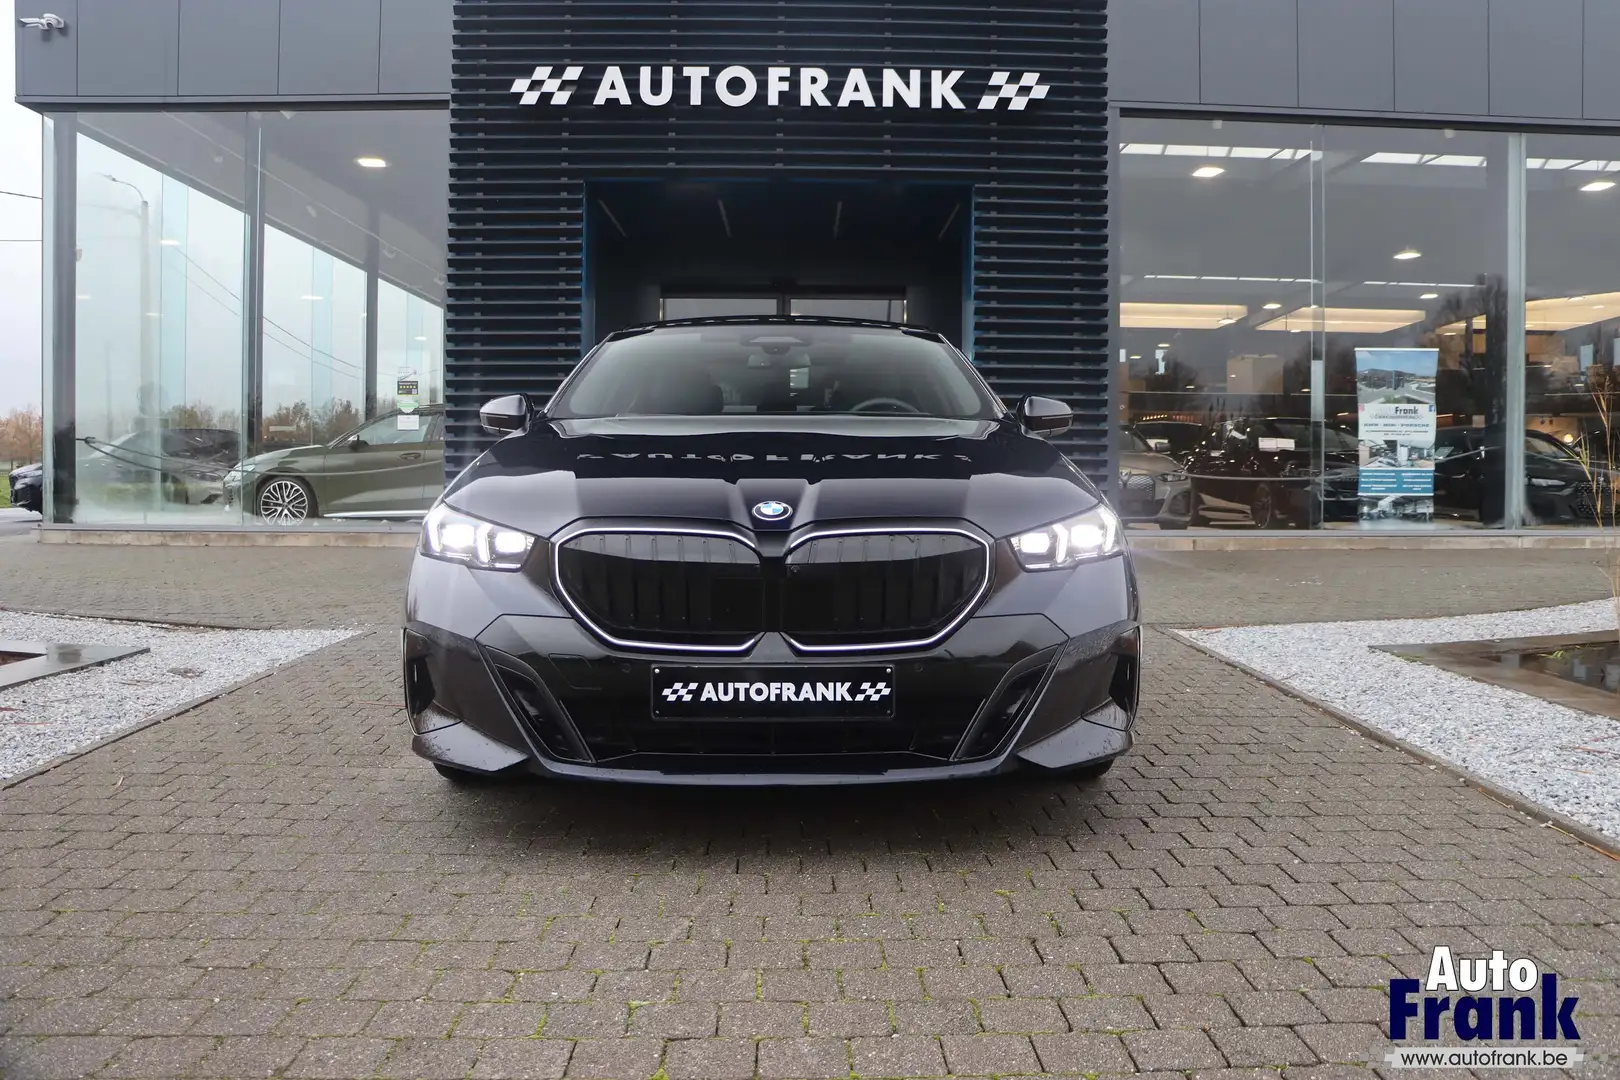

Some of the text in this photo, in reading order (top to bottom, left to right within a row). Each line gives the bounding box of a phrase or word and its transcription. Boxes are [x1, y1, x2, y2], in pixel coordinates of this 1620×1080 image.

[592, 65, 966, 110] AUTOFRANK
[1395, 406, 1419, 415] Frank
[700, 682, 852, 702] AUTOFRANK
